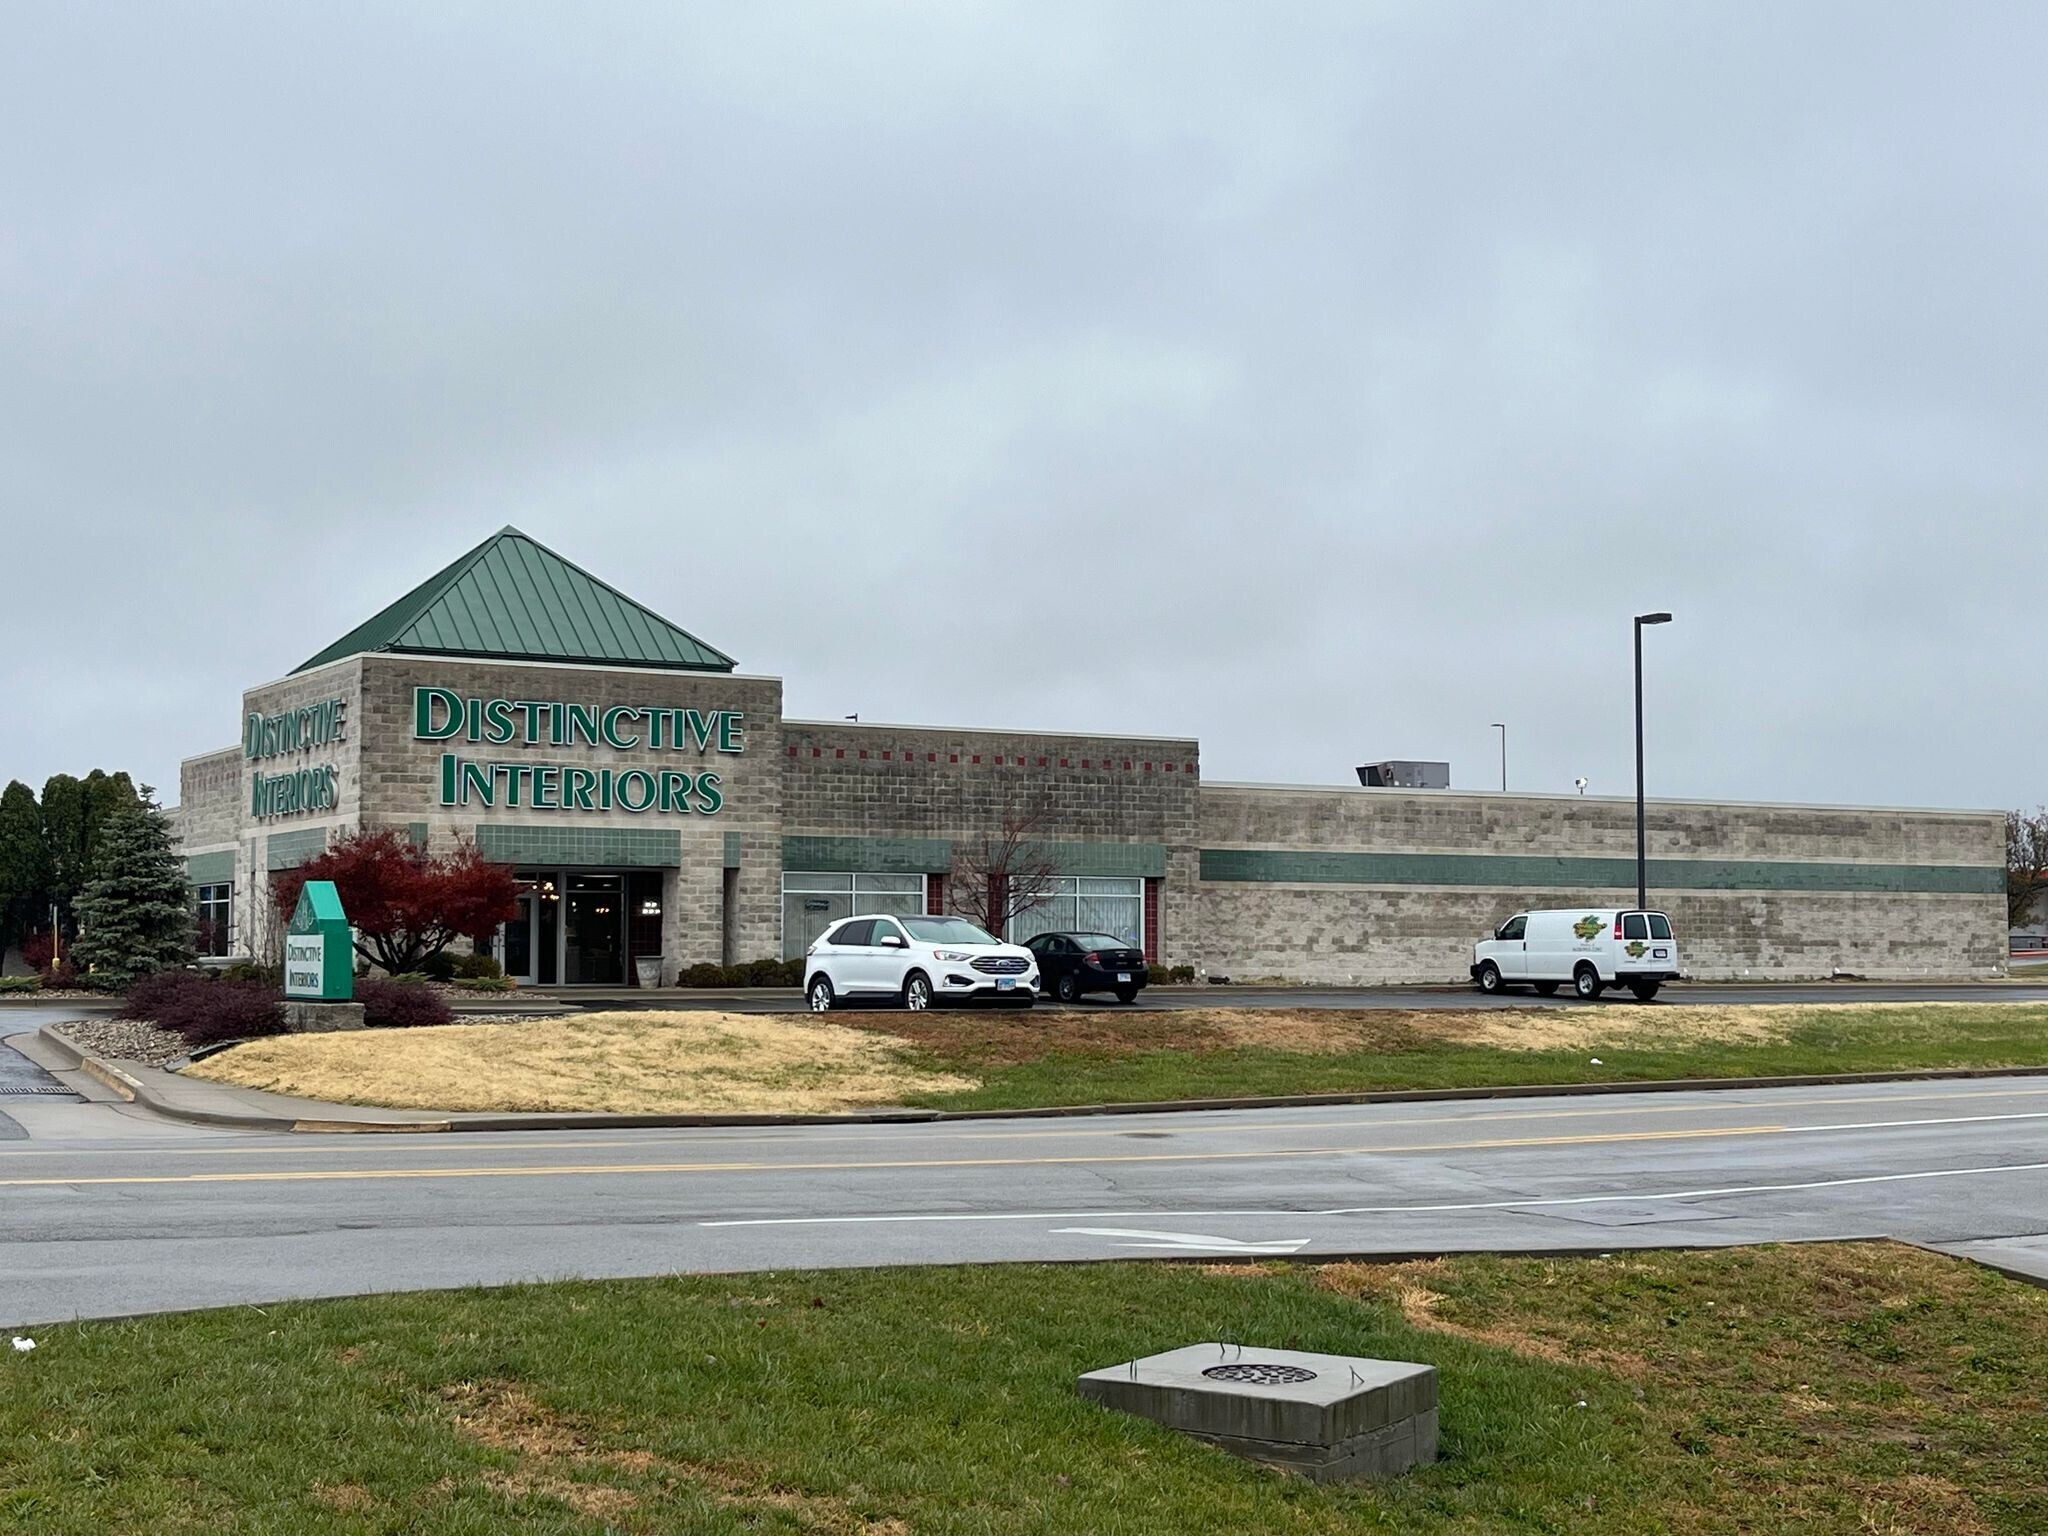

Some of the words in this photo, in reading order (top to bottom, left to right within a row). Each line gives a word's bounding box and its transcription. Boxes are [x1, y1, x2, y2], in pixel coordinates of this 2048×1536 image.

[246, 697, 347, 760] DISTINCTIVE
[413, 685, 745, 754] DISTINCTIVE
[251, 763, 340, 819] INTERIORS
[439, 753, 724, 815] INTERIORS
[288, 943, 321, 961] DISTINCTIVE
[290, 968, 318, 987] INTERIORS
